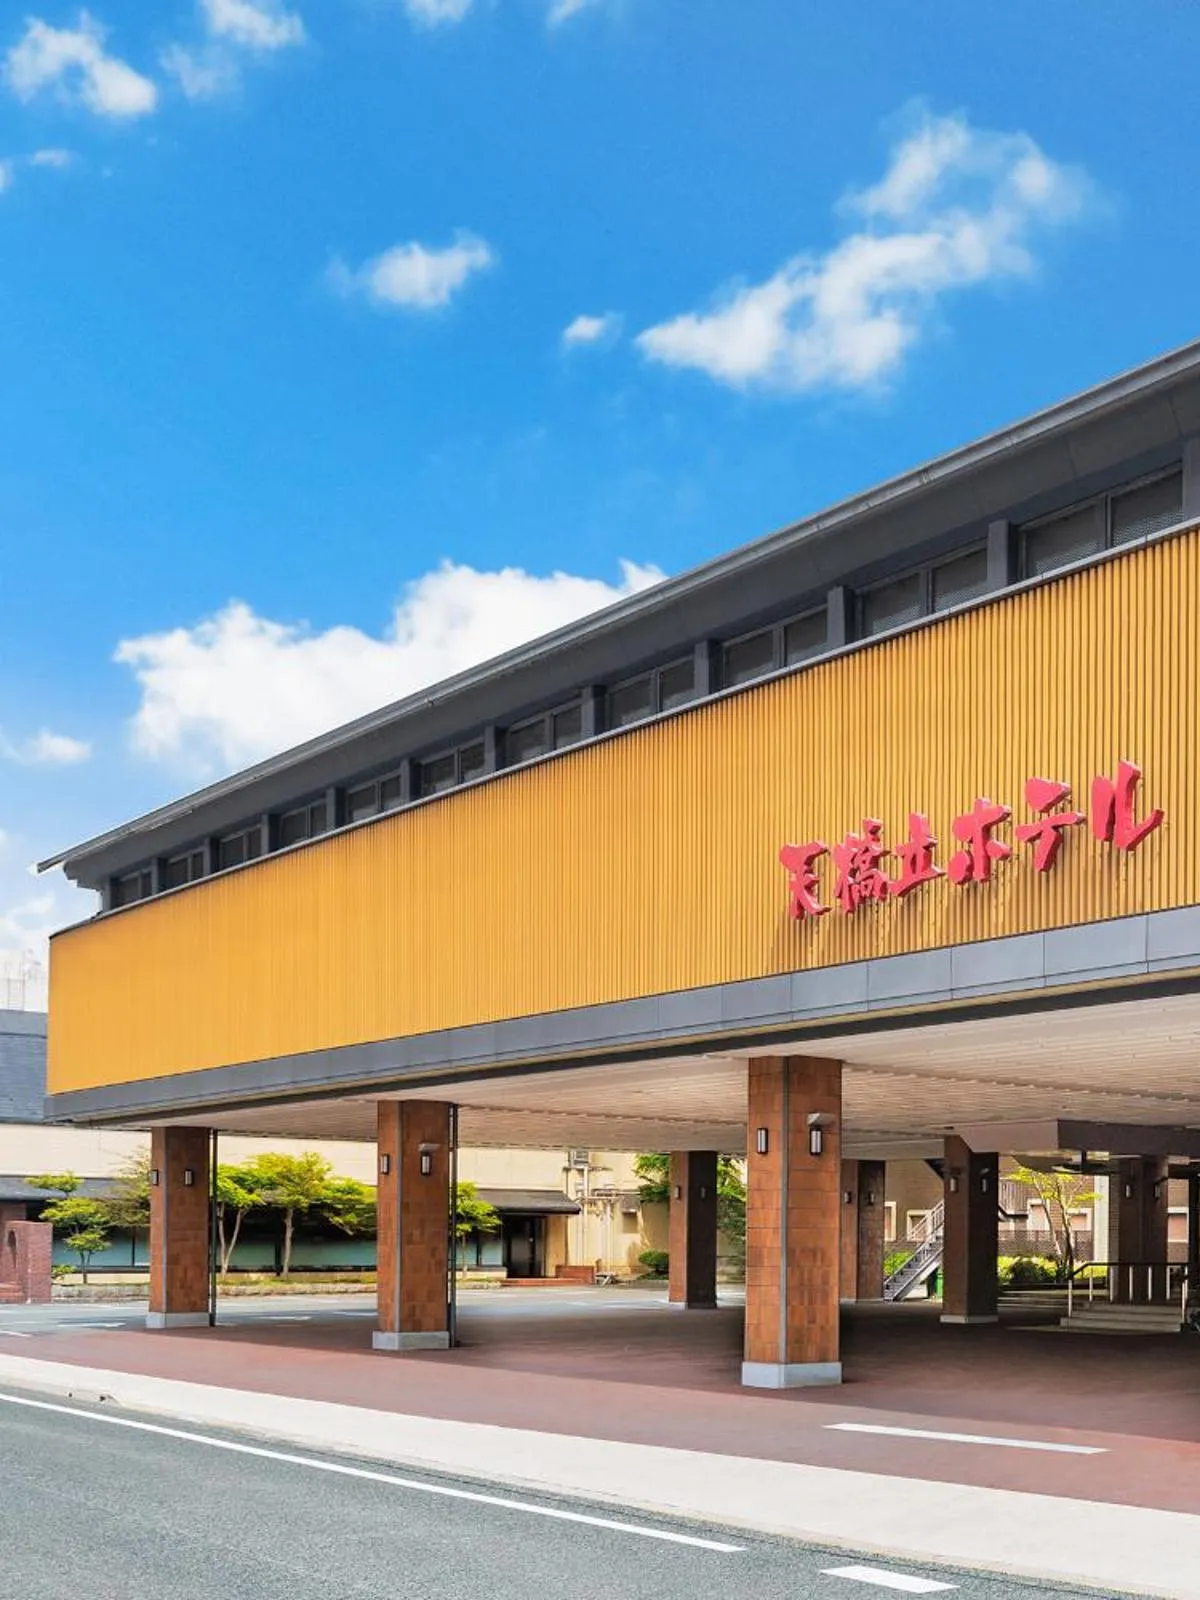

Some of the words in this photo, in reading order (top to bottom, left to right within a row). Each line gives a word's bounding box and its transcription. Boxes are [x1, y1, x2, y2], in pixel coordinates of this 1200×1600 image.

[779, 759, 1166, 920] 天橋立ホテル
